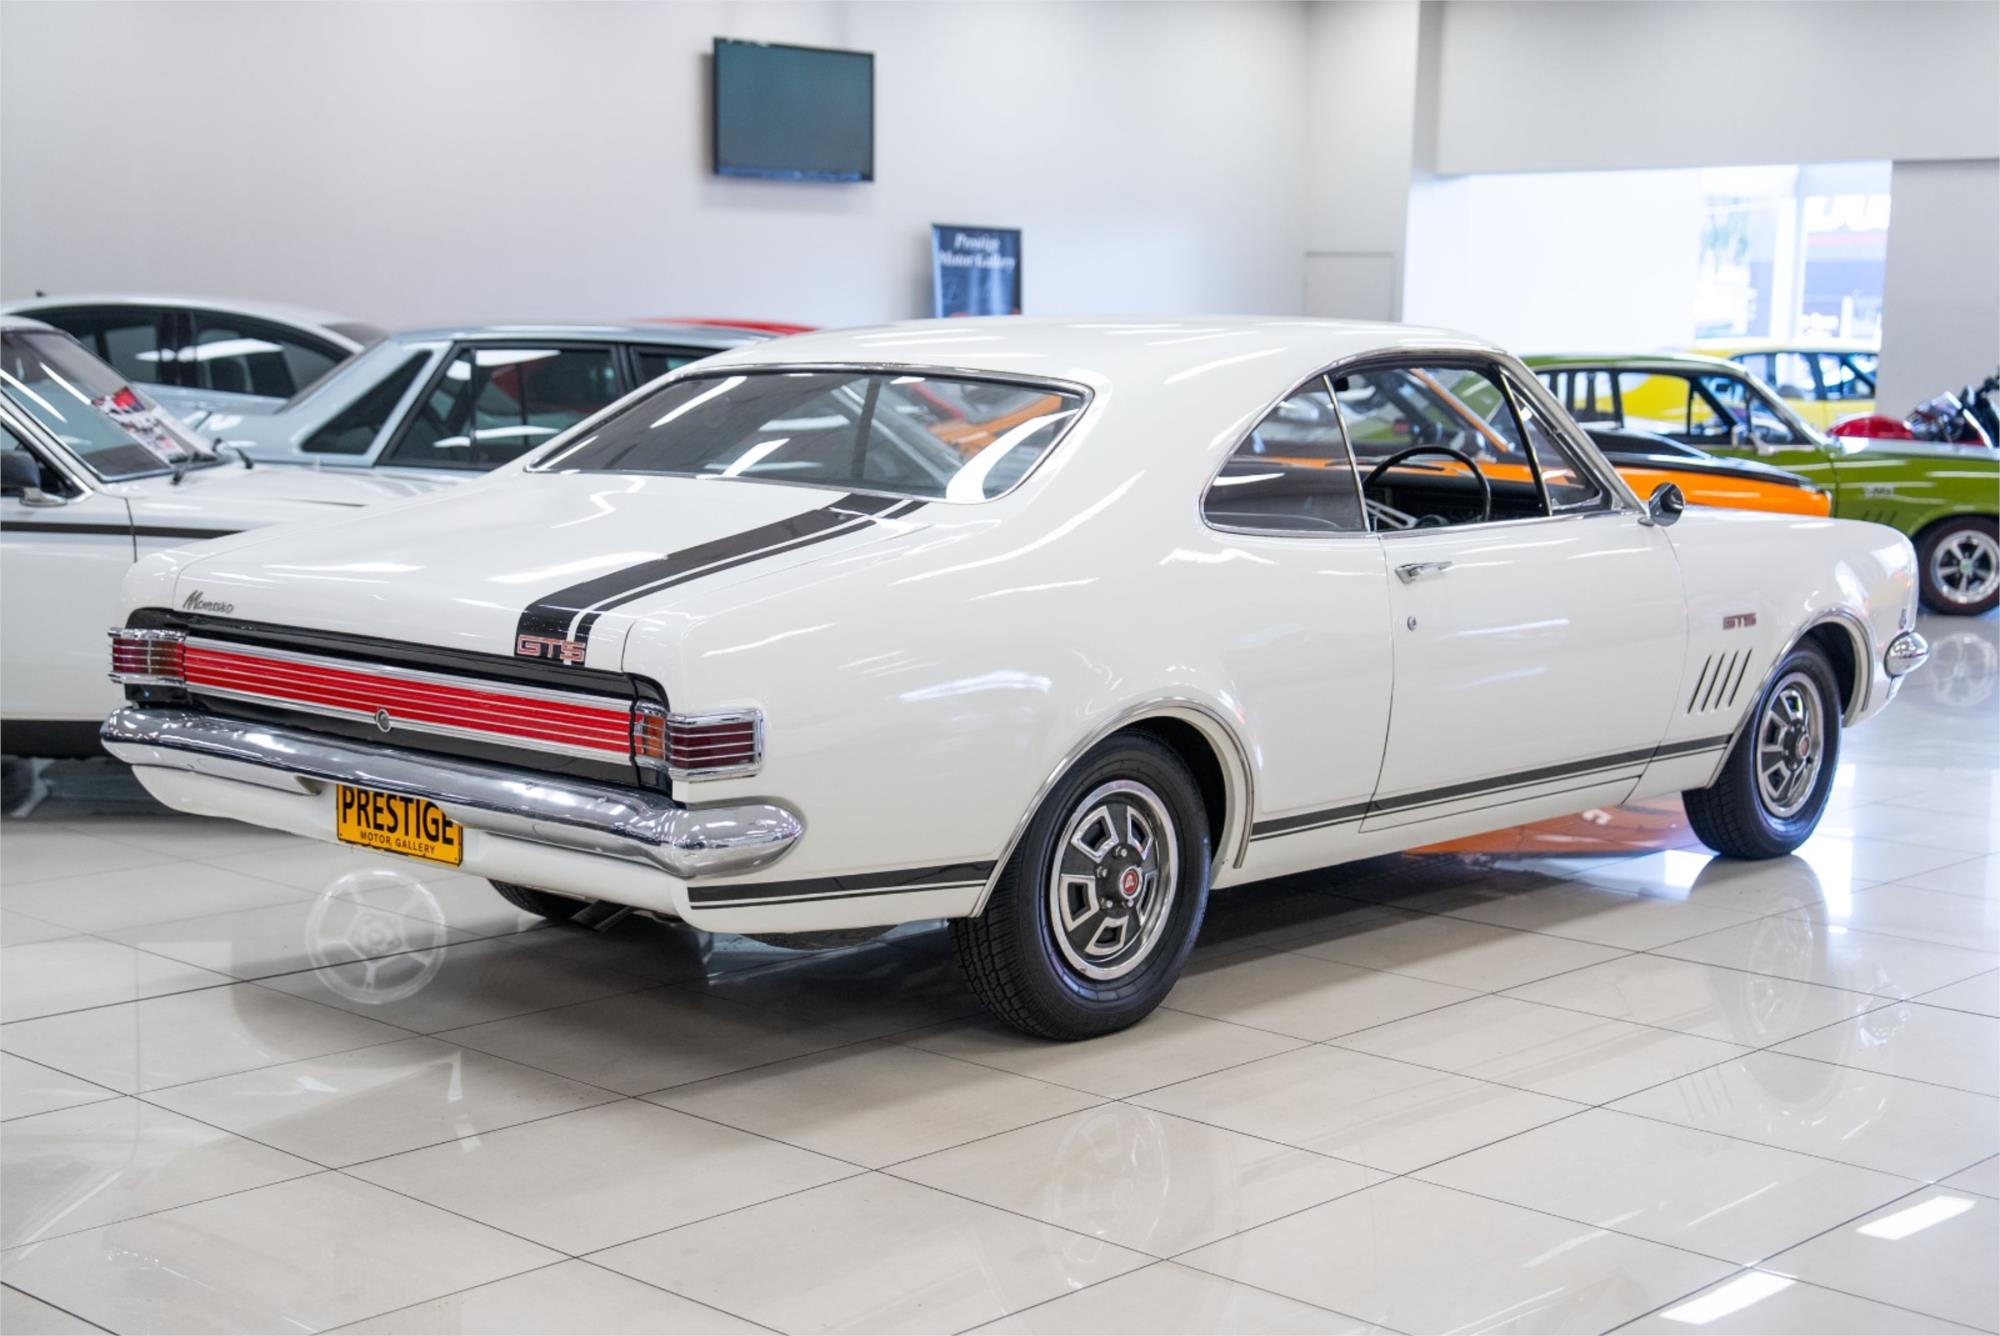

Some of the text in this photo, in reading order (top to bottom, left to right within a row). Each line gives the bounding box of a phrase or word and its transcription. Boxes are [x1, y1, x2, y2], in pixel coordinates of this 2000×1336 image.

[1722, 612, 1757, 630] GTS
[517, 634, 586, 662] GTS
[342, 785, 455, 845] PRESTIGE
[360, 830, 436, 855] MOTOR GALLERY
